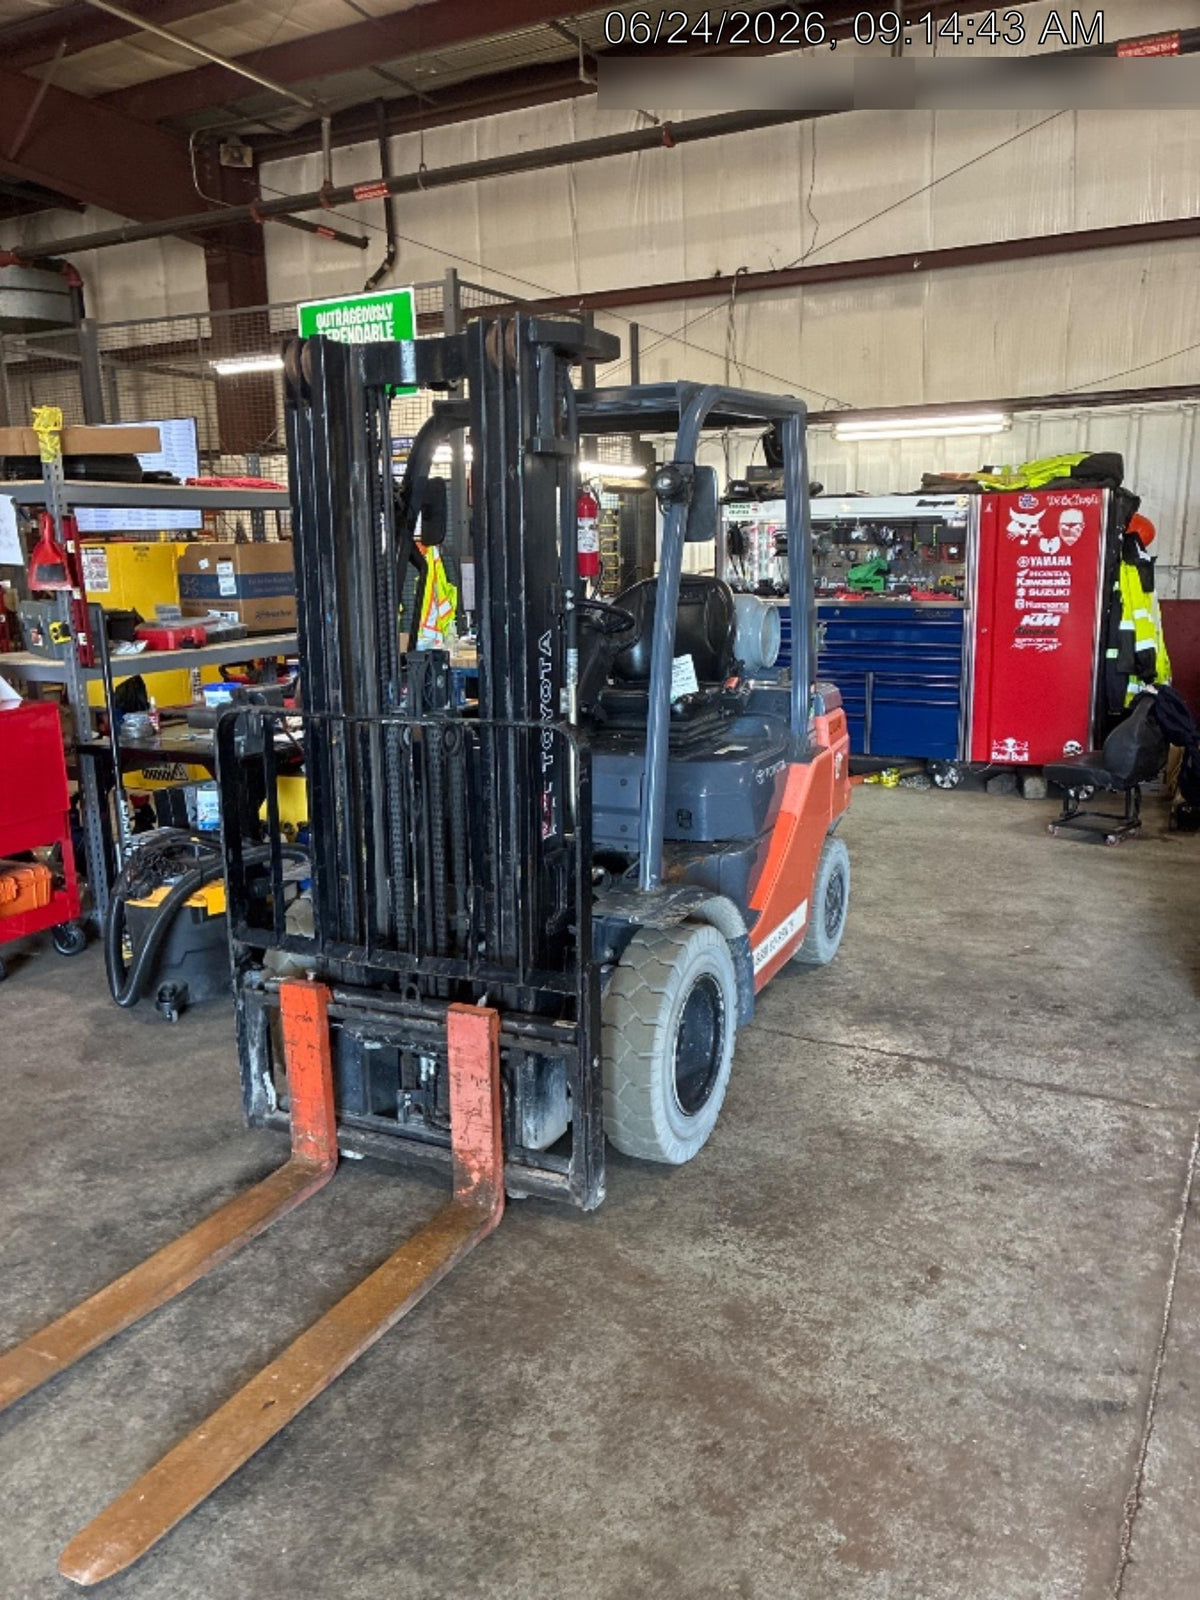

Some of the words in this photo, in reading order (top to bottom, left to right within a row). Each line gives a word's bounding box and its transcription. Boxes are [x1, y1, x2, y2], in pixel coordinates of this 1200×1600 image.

[316, 302, 393, 329] OUTRAGEOUSLY
[318, 322, 394, 343] EPENDABLE
[1029, 556, 1072, 566] YAMAHA
[1016, 577, 1071, 587] Kawasaki
[1028, 587, 1070, 596] SUZUKI
[1020, 613, 1062, 626] KTM
[539, 630, 553, 773] TOYOTA
[1011, 752, 1029, 762] Bull
